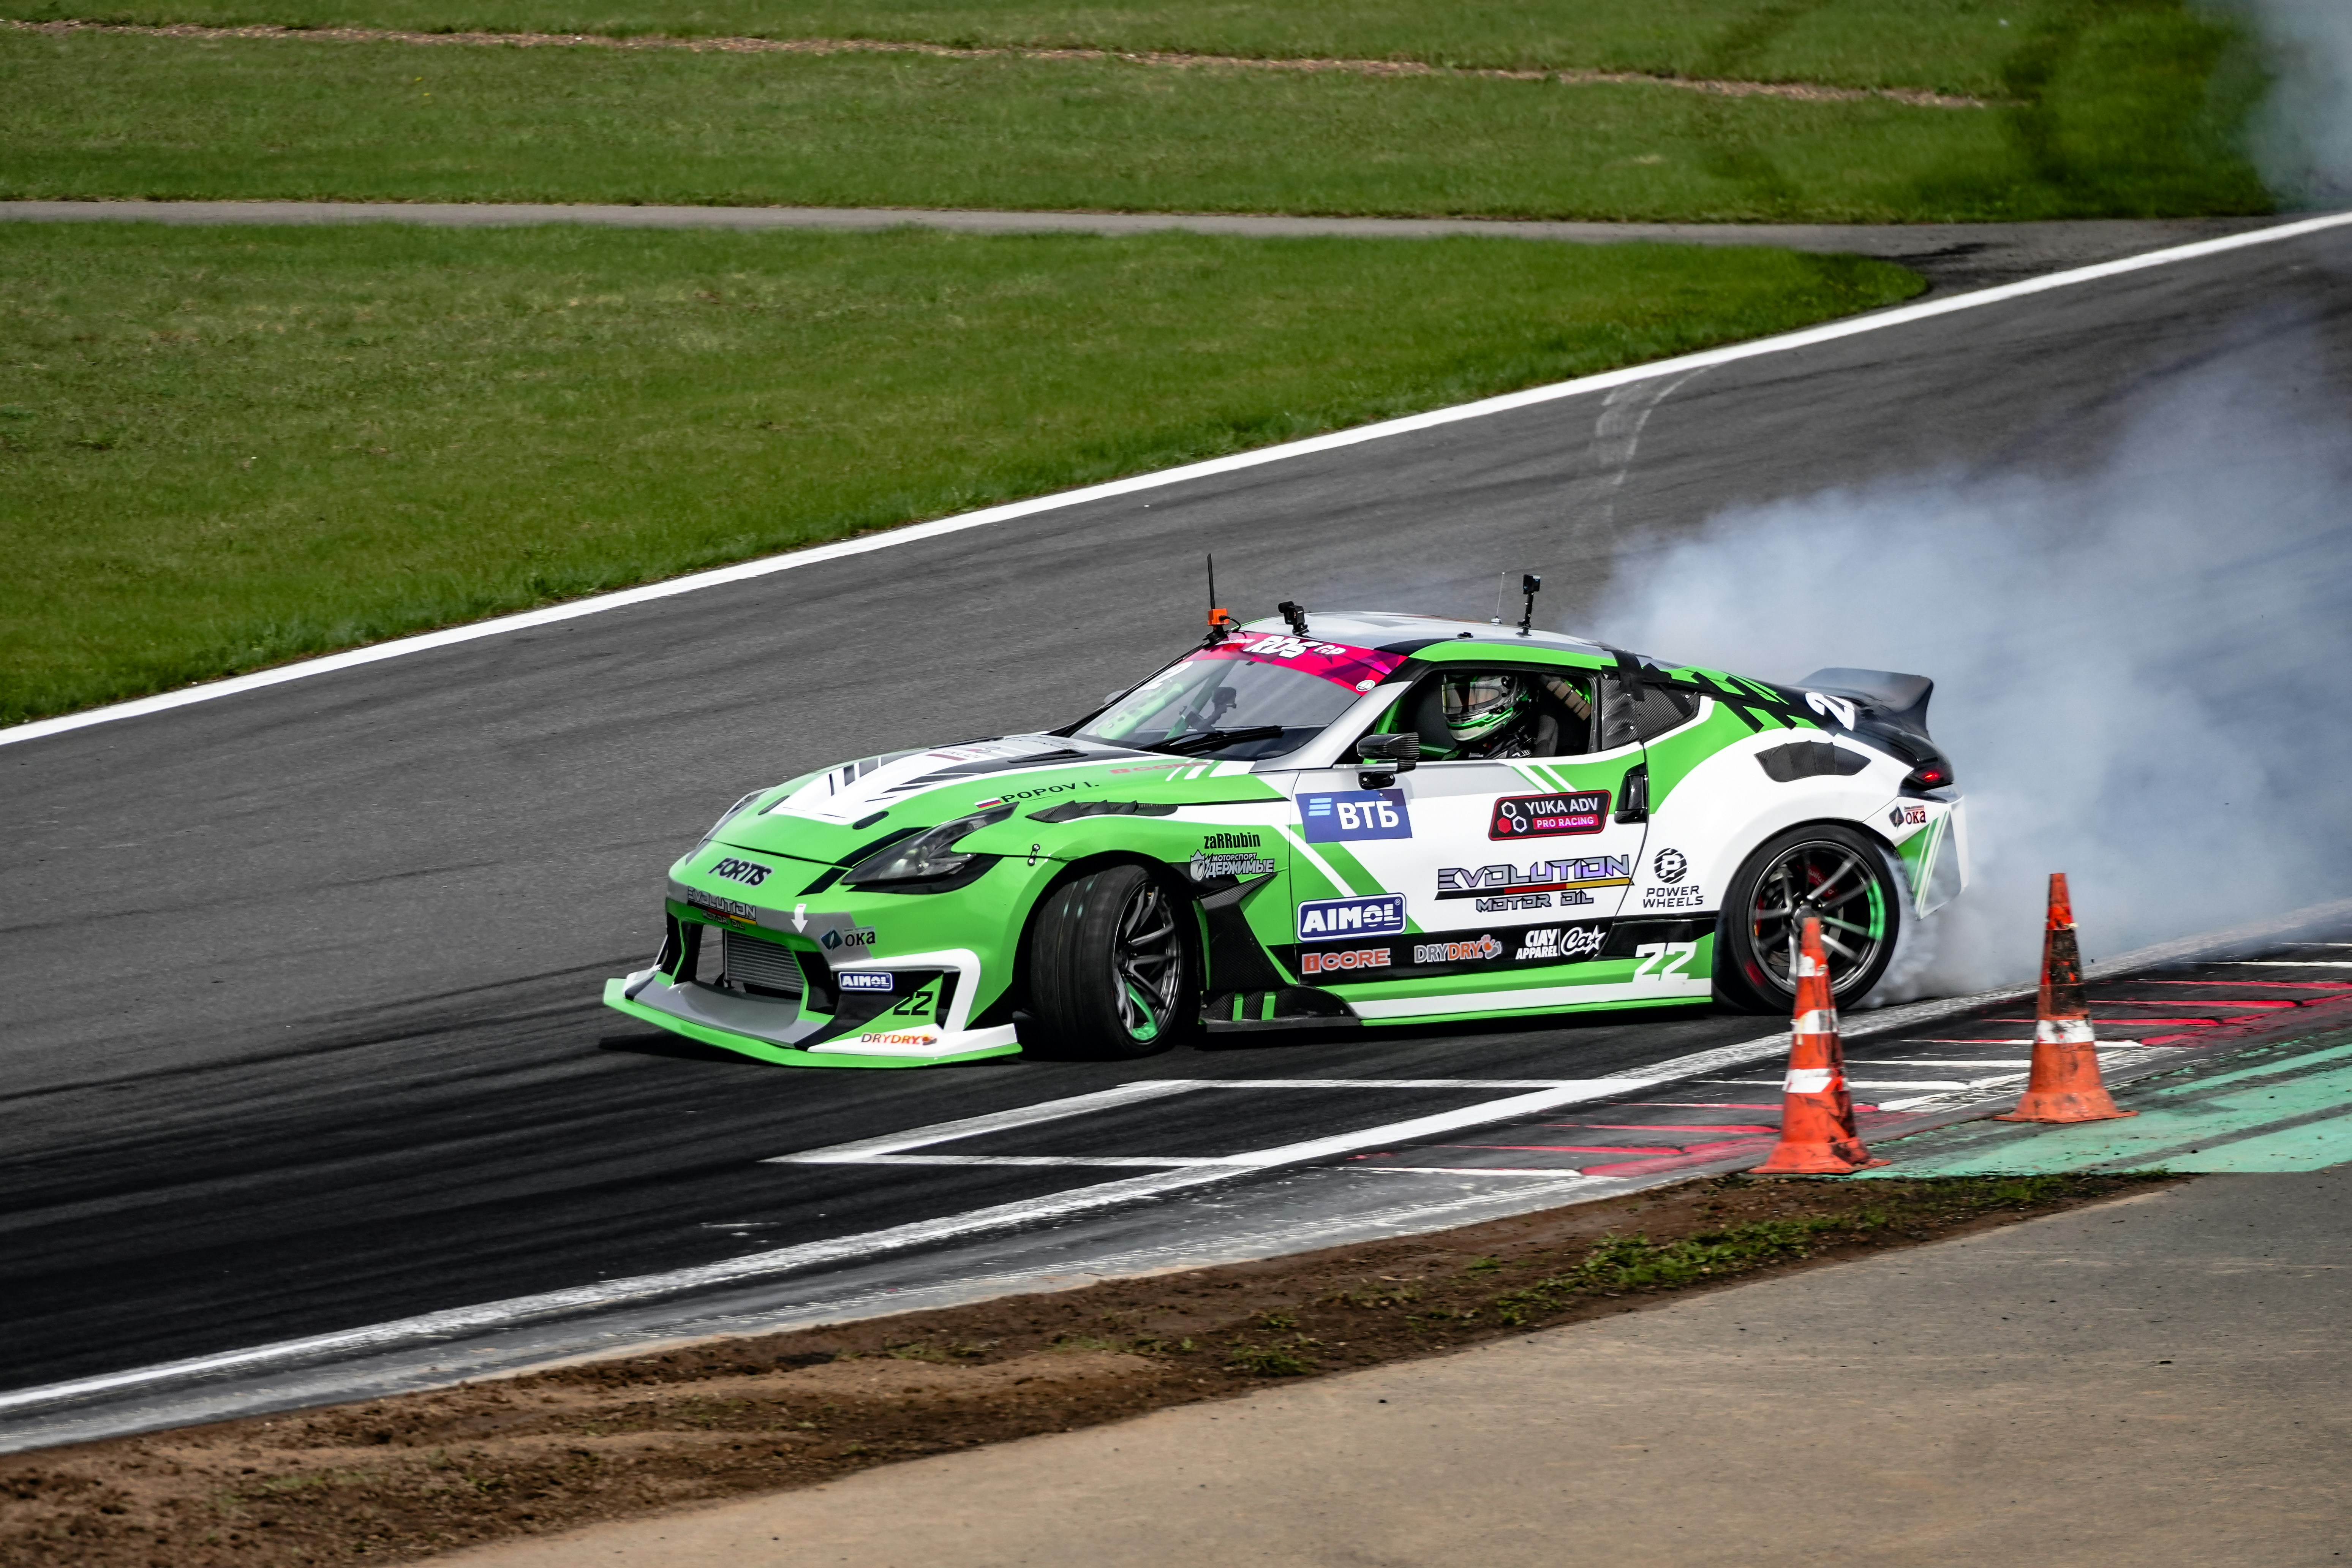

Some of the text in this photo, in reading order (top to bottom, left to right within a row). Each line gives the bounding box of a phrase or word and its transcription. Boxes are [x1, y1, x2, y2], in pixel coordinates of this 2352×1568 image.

[1001, 783, 1075, 803] POPOV
[1336, 800, 1399, 830] ВТБ
[1525, 798, 1598, 815] YUKA ADV
[1536, 816, 1594, 828] PRO RACING
[1204, 832, 1261, 849] zaRRubin
[1211, 853, 1257, 861] МОТОРСПОРТ
[1438, 854, 1629, 890] EVOLUTION
[1476, 889, 1594, 912] MOTOR OIL
[1646, 885, 1699, 897] POWER
[688, 886, 757, 919] EVOLUTION
[1643, 896, 1704, 908] WHEELS
[702, 910, 746, 930] MOTOR OIL
[1302, 903, 1401, 933] AIMOL
[1414, 941, 1482, 963] DRYDRY
[1515, 945, 1558, 960] APPAREL
[1633, 942, 1697, 983] 22
[842, 975, 890, 986] AIMOL
[893, 991, 933, 1015] 22
[861, 1033, 920, 1045] DRYDRY
